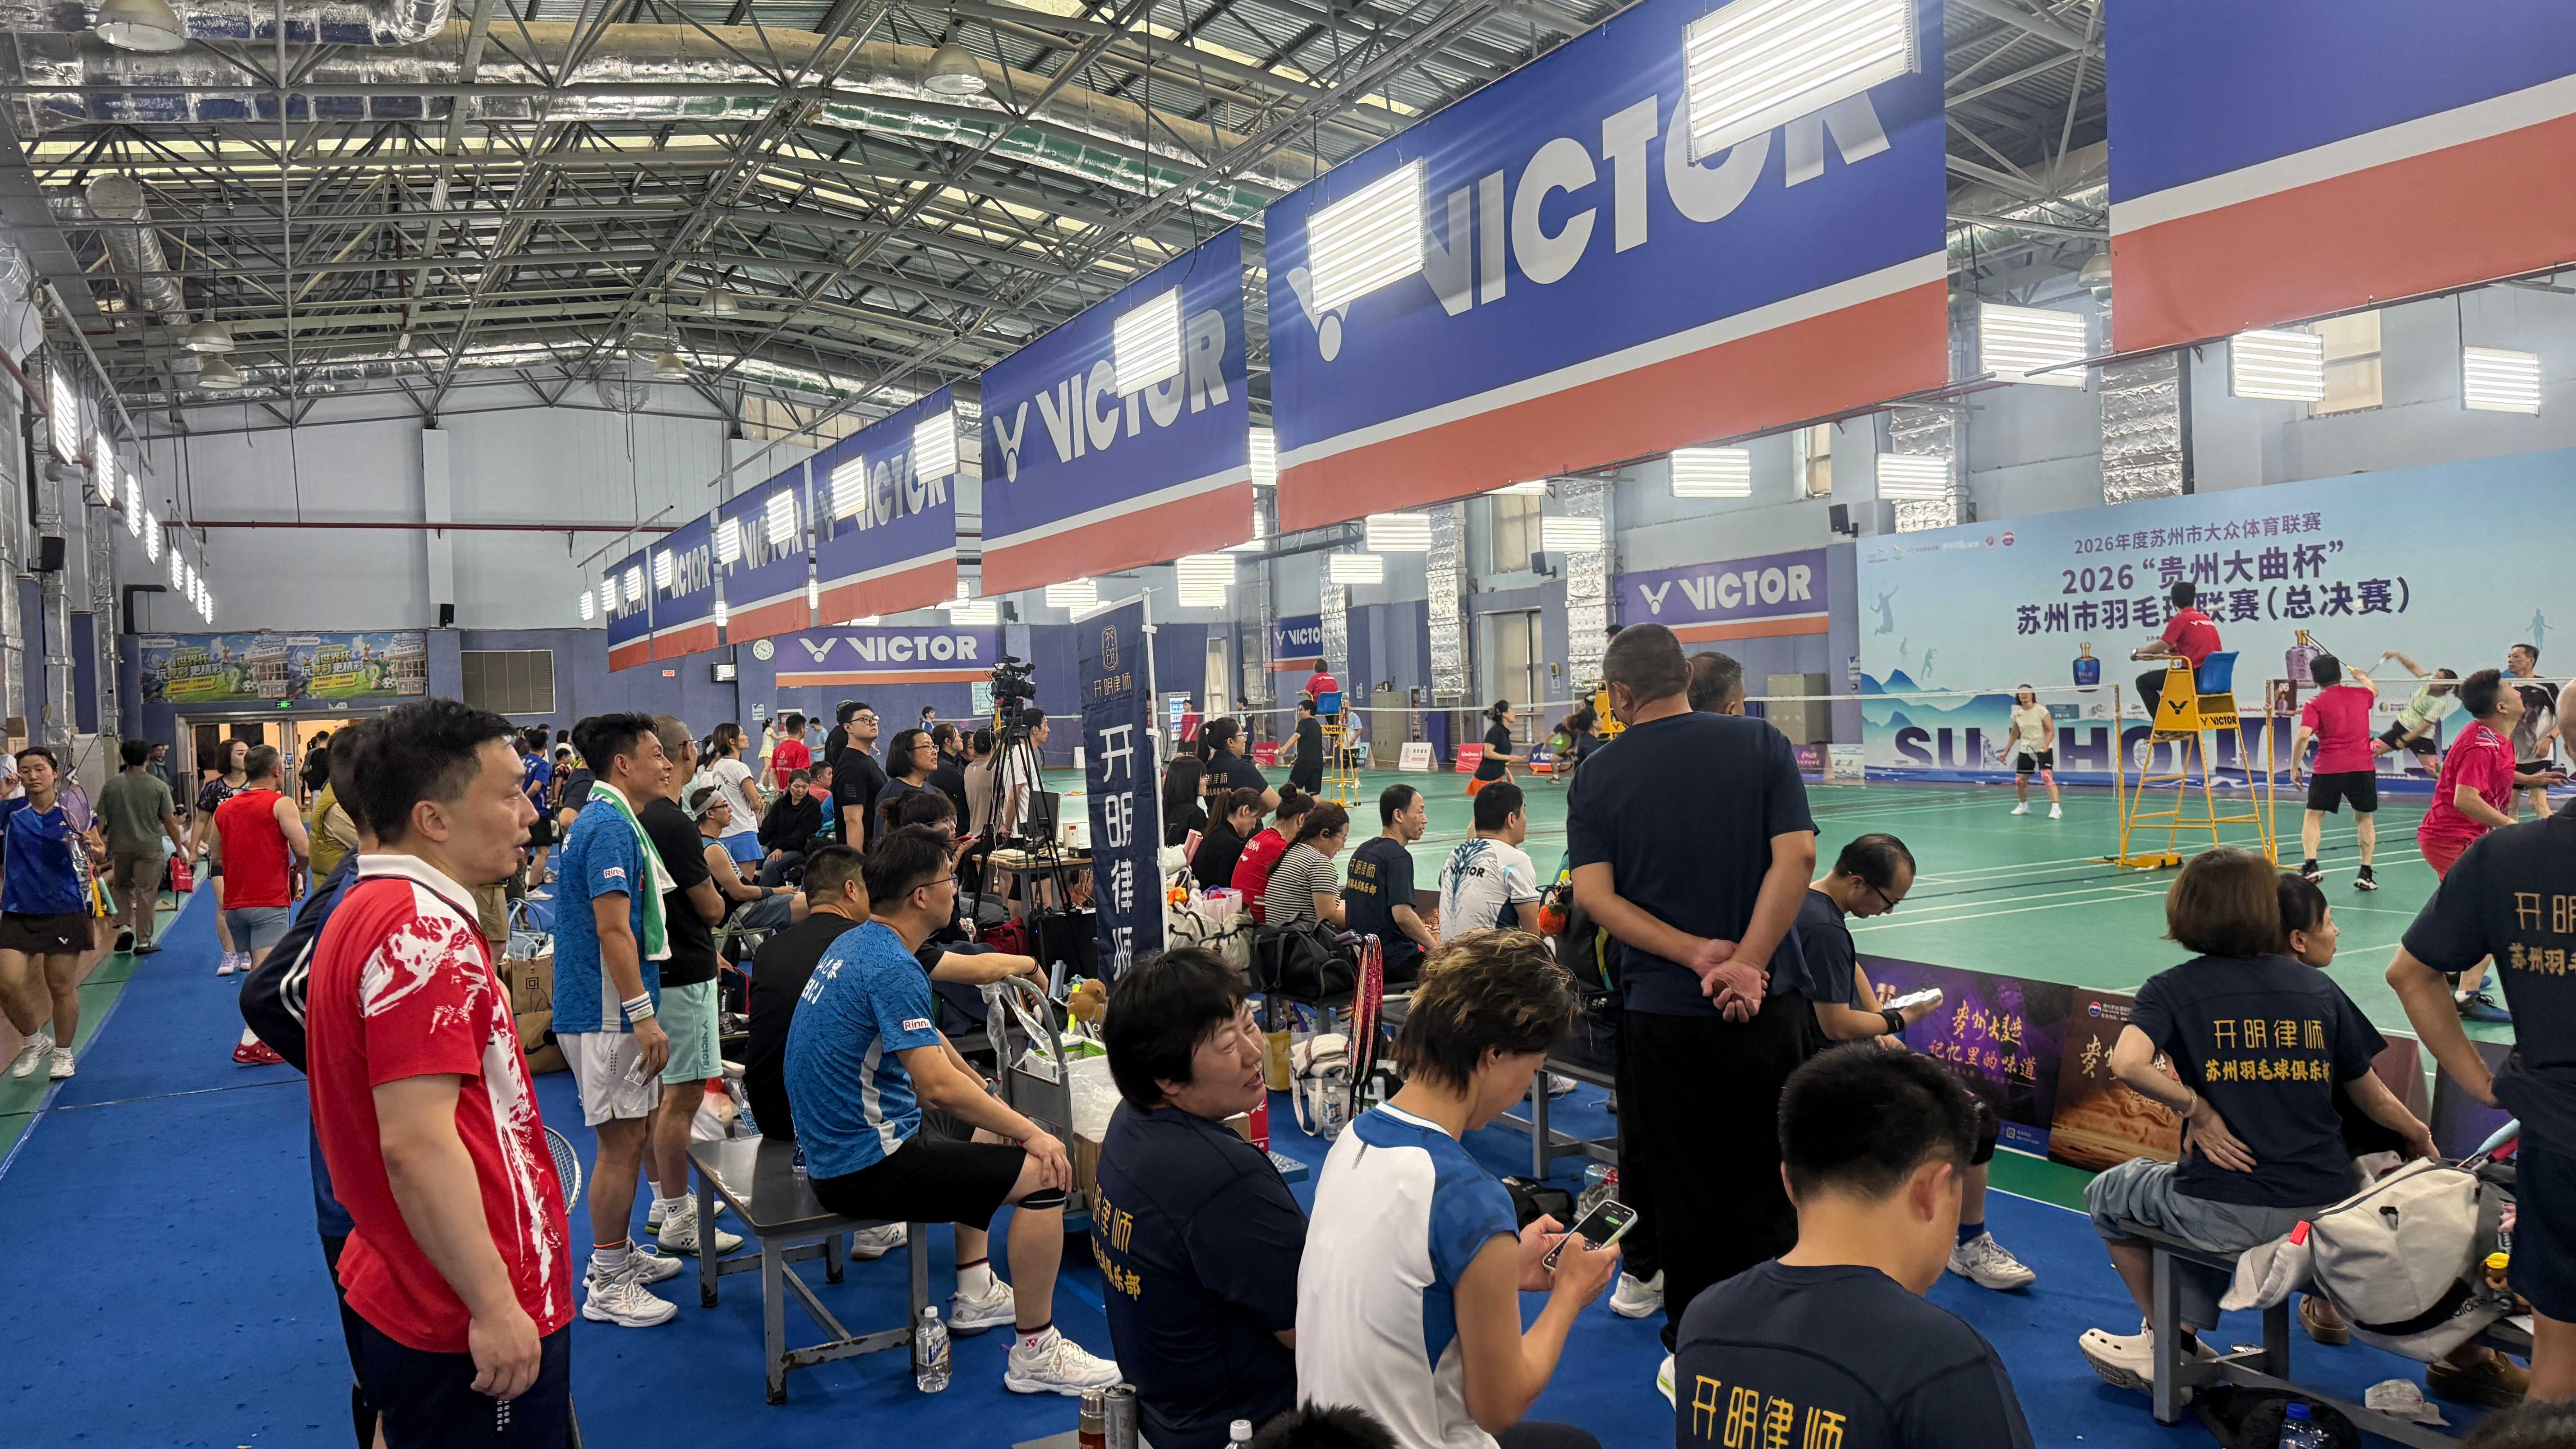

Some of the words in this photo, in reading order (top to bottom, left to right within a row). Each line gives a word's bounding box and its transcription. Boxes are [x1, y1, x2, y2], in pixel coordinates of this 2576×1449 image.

[855, 446, 947, 531] ICTO
[2075, 511, 2322, 555] 2026年度苏州市大众体育联赛
[1678, 565, 1812, 610] VICTOR
[845, 635, 978, 662] VICTOR
[1288, 627, 1323, 645] VICTO
[1094, 672, 1132, 698] 开明律师
[2210, 716, 2237, 726] VICTOR
[1205, 773, 1228, 785] 明律师
[1099, 723, 1134, 982] 开明律师
[1450, 866, 1485, 878] VICTOR
[904, 1021, 930, 1030] Rinn
[2213, 1019, 2325, 1050] 开明律师
[1928, 1039, 2037, 1080] 记忆里的味道
[1092, 1183, 1133, 1254] 明律师
[1692, 1375, 1846, 1449] 开明律师
